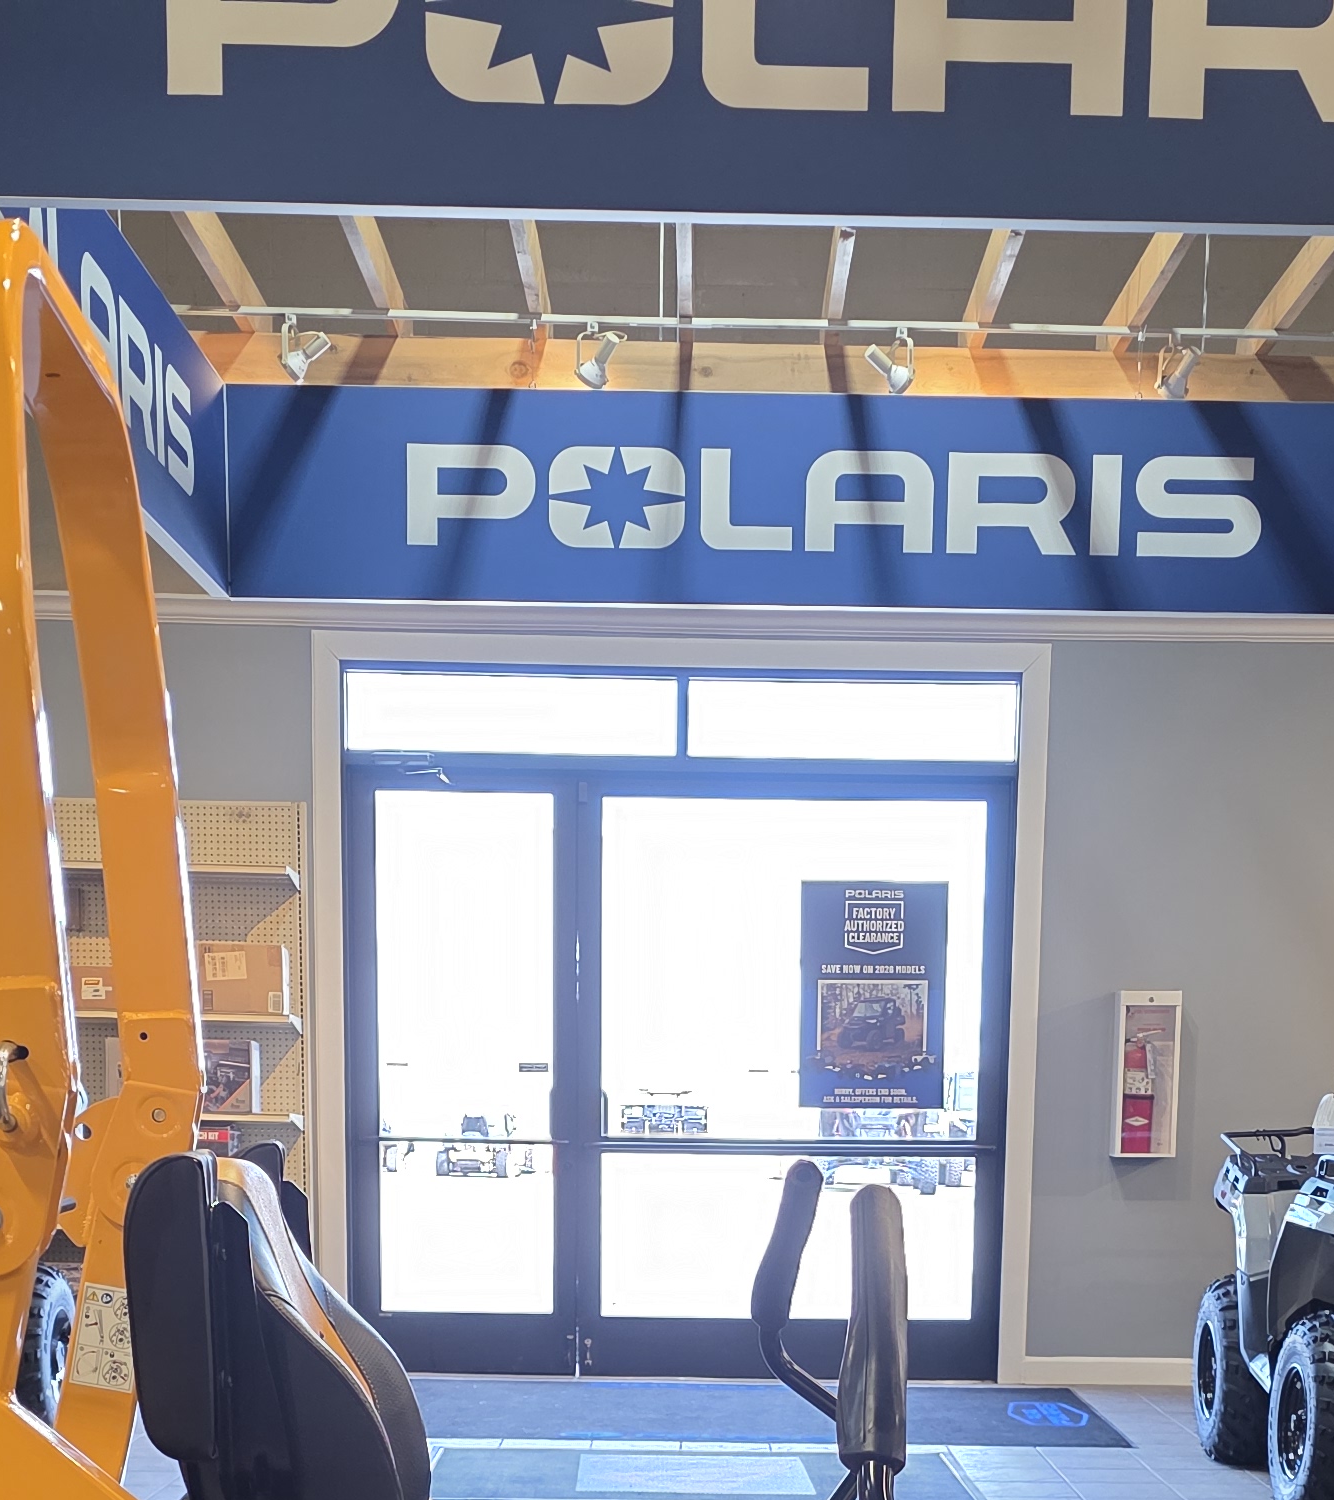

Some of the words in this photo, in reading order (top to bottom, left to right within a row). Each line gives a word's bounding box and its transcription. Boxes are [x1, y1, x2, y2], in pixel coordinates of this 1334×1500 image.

[407, 442, 1261, 558] POLARIS
[845, 889, 904, 898] POLARIS
[852, 907, 896, 919] FACTORY
[844, 920, 905, 932] AUTHORIZED
[848, 933, 900, 943] CLEARANCE
[821, 964, 841, 974] SAVE
[842, 964, 861, 974] NOW
[863, 965, 873, 974] ON
[895, 965, 926, 975] MODELS
